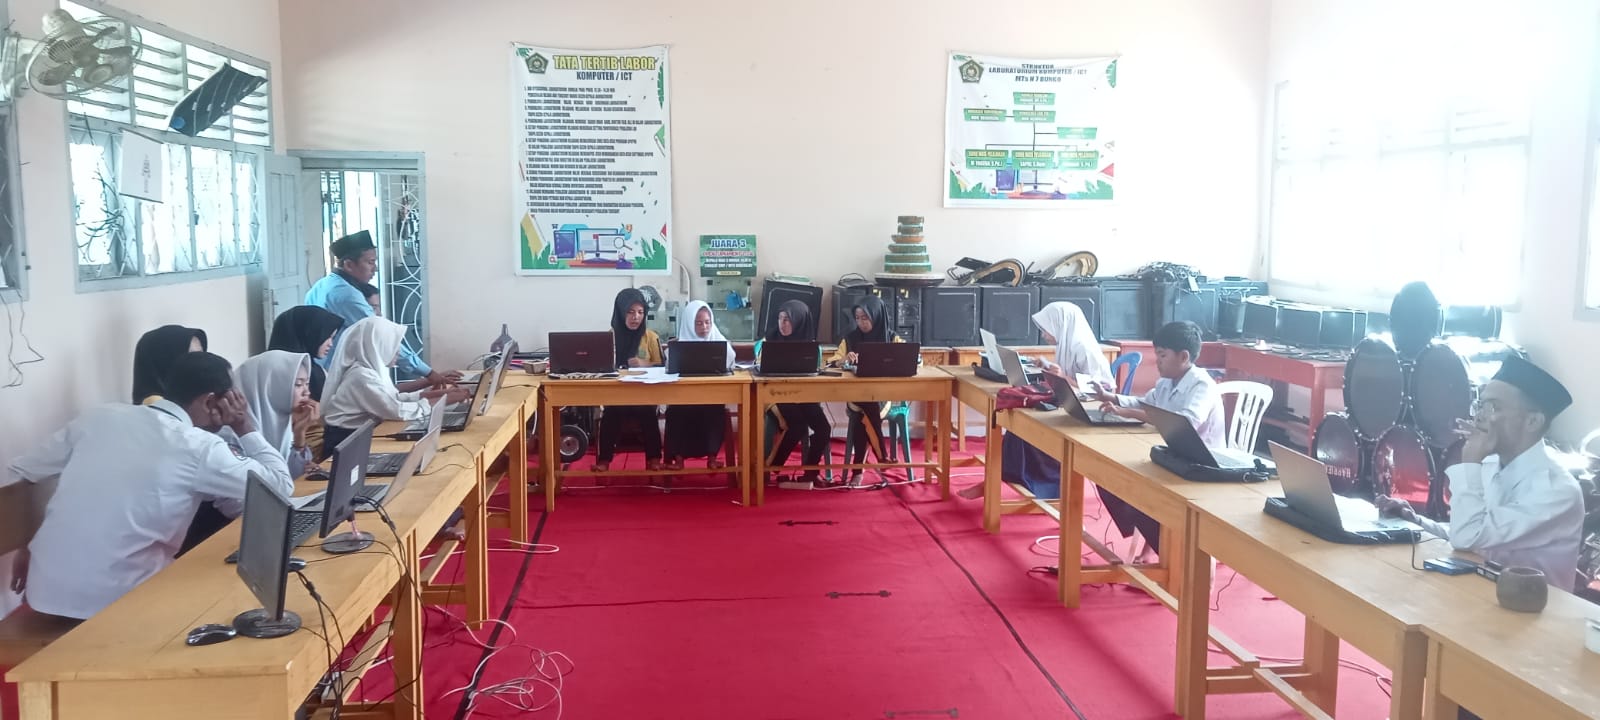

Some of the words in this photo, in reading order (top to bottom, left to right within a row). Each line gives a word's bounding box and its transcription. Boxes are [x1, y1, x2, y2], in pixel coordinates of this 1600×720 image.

[552, 55, 579, 70] TATA
[580, 55, 618, 70] TERTIB
[620, 56, 655, 70] LABOR
[577, 71, 614, 80] KOMPUTER
[616, 72, 619, 80] /
[621, 72, 632, 80] ICT
[710, 239, 738, 248] JUARA
[740, 239, 746, 248] 3
